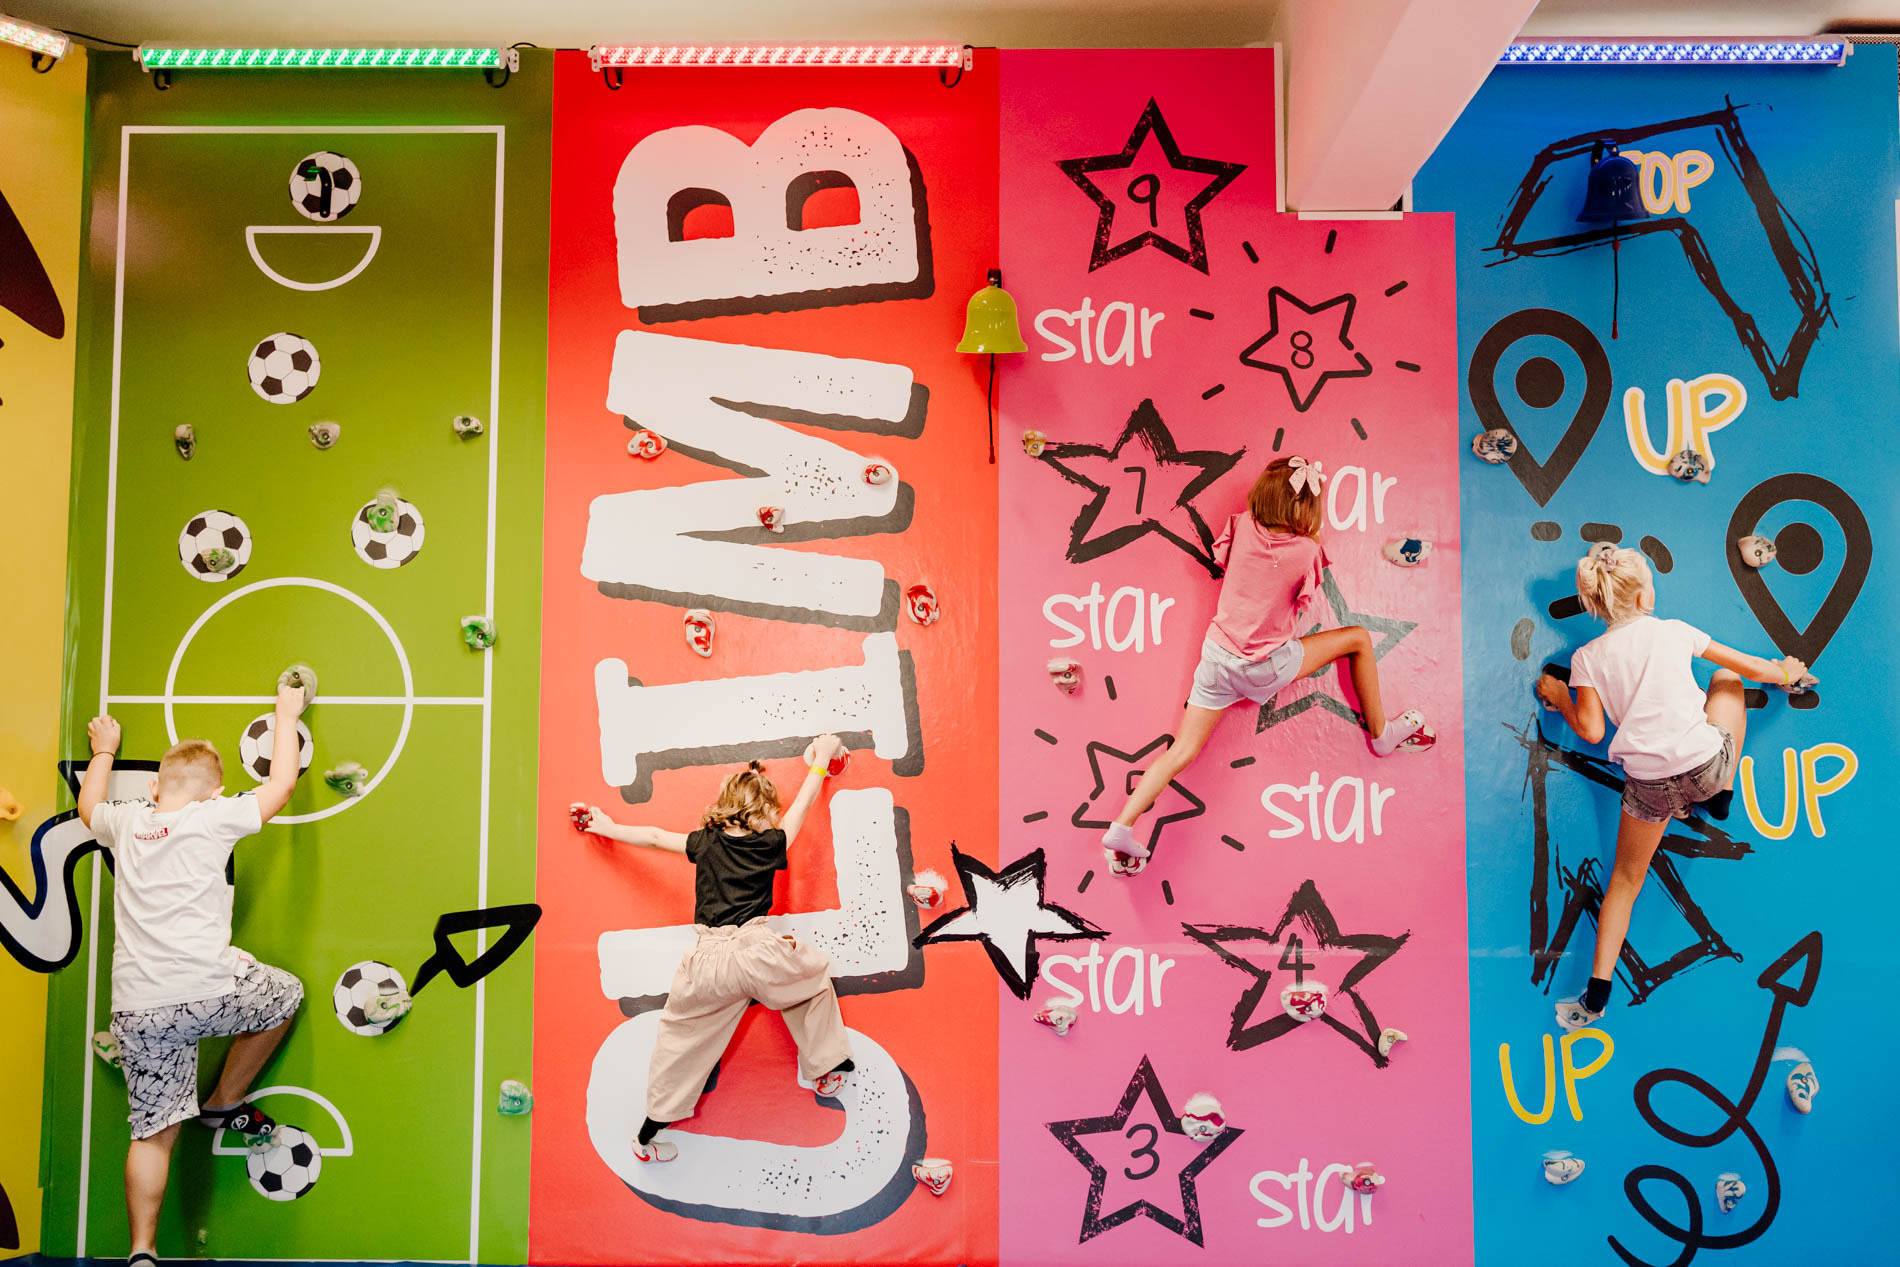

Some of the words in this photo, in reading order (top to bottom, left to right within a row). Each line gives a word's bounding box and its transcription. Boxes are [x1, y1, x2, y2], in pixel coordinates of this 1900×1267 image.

[1126, 173, 1161, 227] 9
[1034, 297, 1165, 366] star
[1290, 330, 1314, 369] 8
[1623, 373, 1747, 475] UP
[1124, 467, 1146, 515] 7
[1042, 581, 1175, 654] star
[580, 107, 932, 1232] CLIMB
[1261, 771, 1395, 844] star
[1740, 742, 1858, 840] UP
[1041, 942, 1175, 1016] star
[1278, 933, 1316, 992] 4
[1499, 1027, 1614, 1125] UP
[1124, 1123, 1160, 1180] 3
